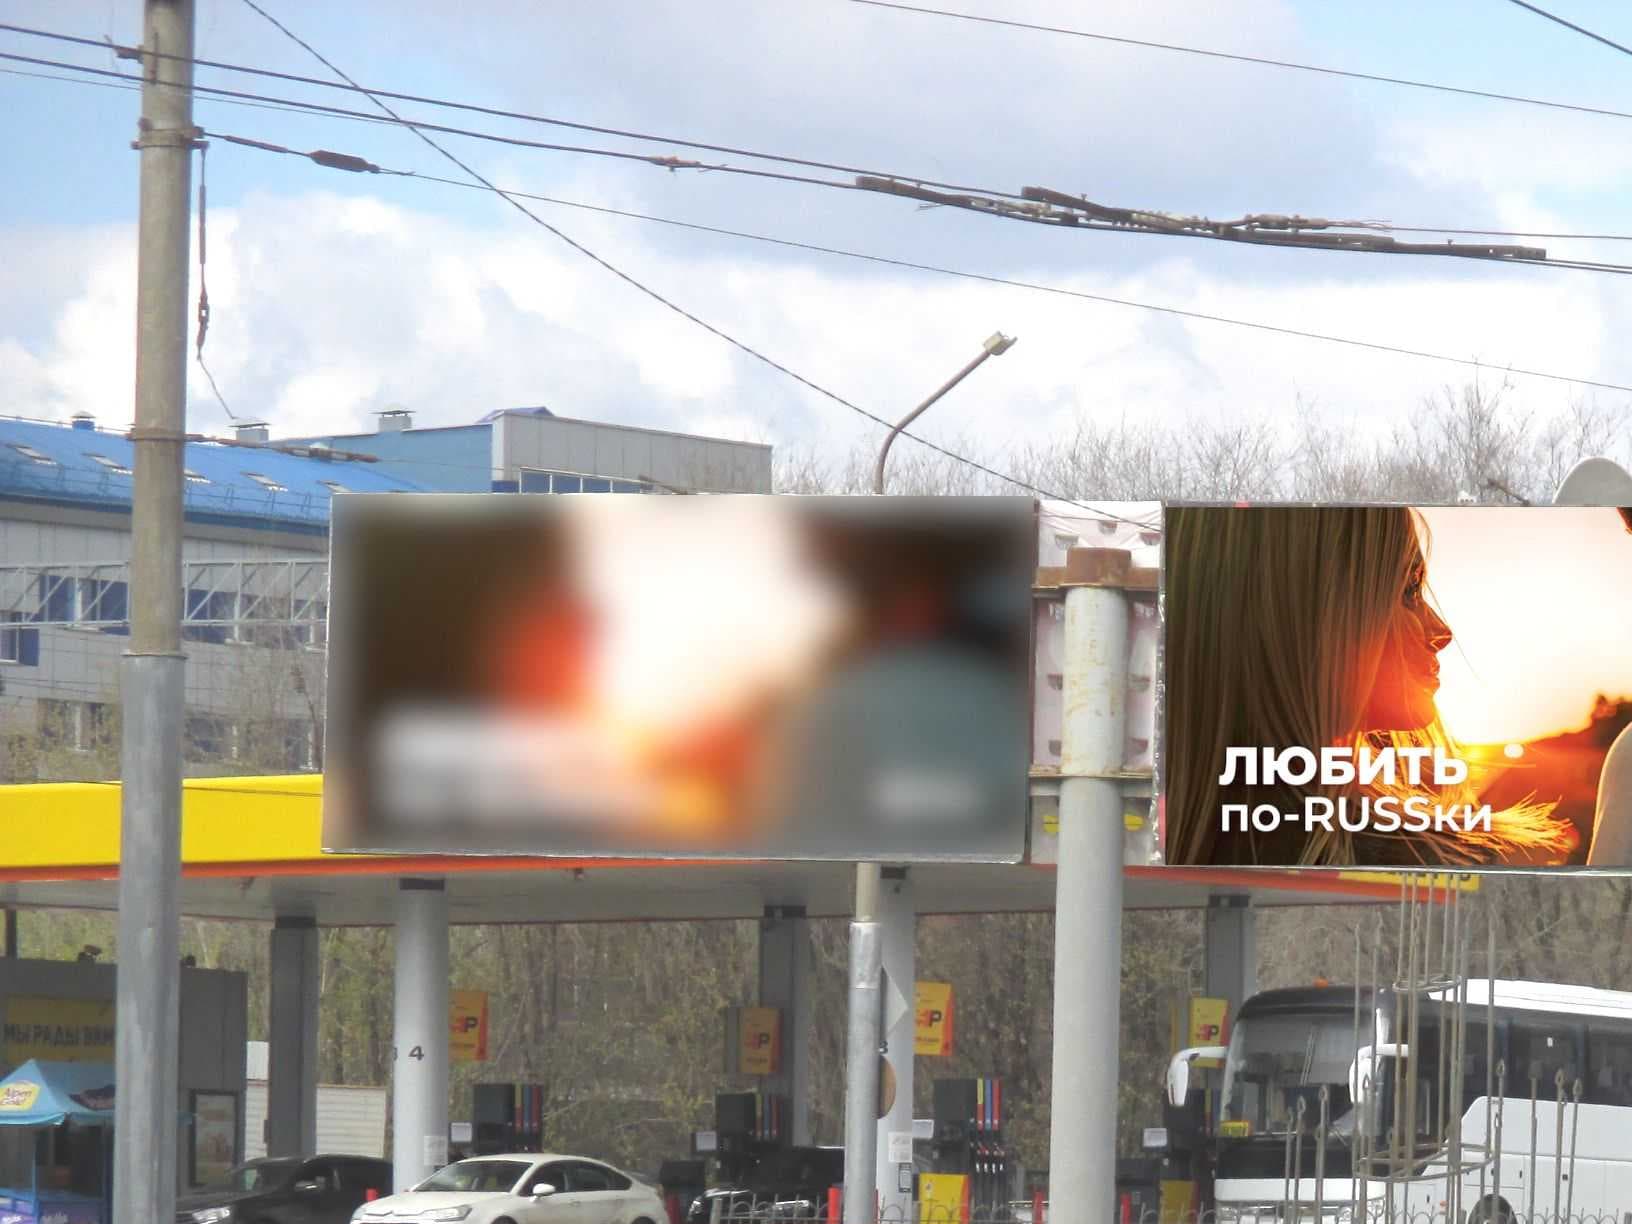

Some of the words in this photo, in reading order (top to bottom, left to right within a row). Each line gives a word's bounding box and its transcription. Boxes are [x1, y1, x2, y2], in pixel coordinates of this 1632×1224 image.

[1218, 746, 1469, 786] ЛЮБИТЬ
[1220, 796, 1493, 833] по-RUSSки
[408, 1045, 425, 1062] 4
